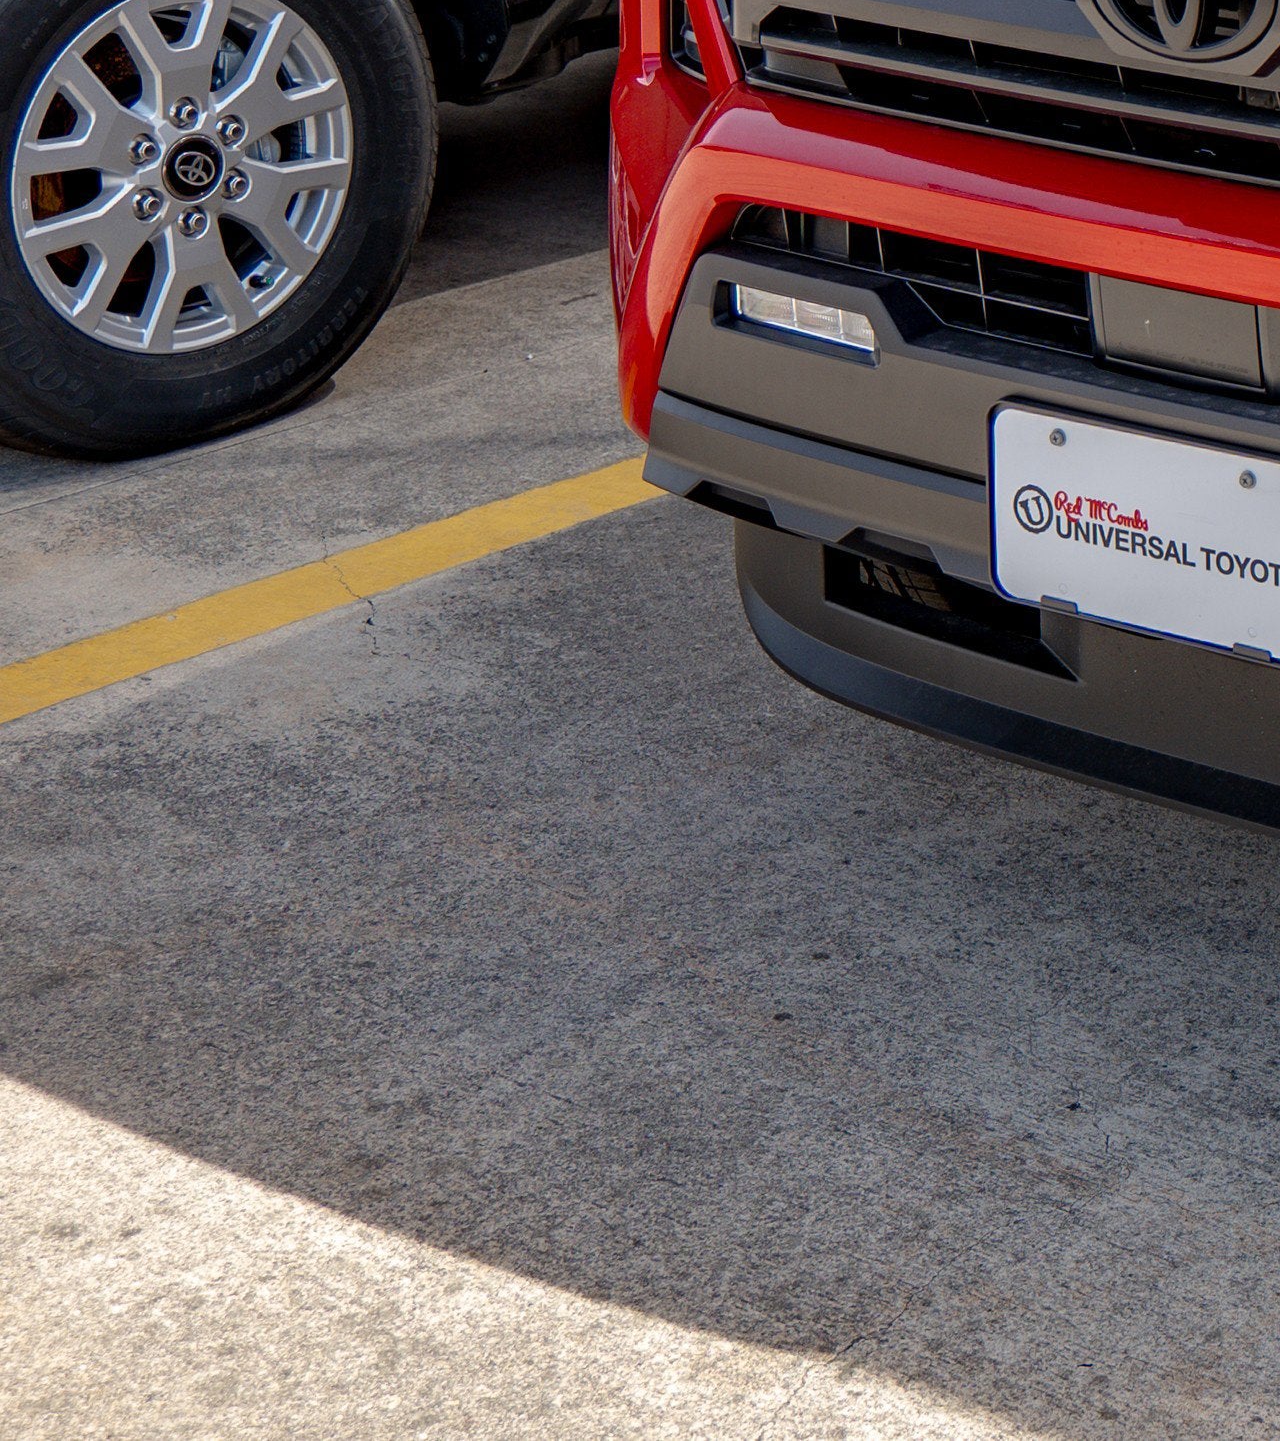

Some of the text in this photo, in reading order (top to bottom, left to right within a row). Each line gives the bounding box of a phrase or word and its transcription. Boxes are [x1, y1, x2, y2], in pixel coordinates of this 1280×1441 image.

[251, 285, 369, 398] TERRITORY
[1054, 490, 1149, 531] Red McCombs
[1055, 514, 1197, 568] UNIVERSAL
